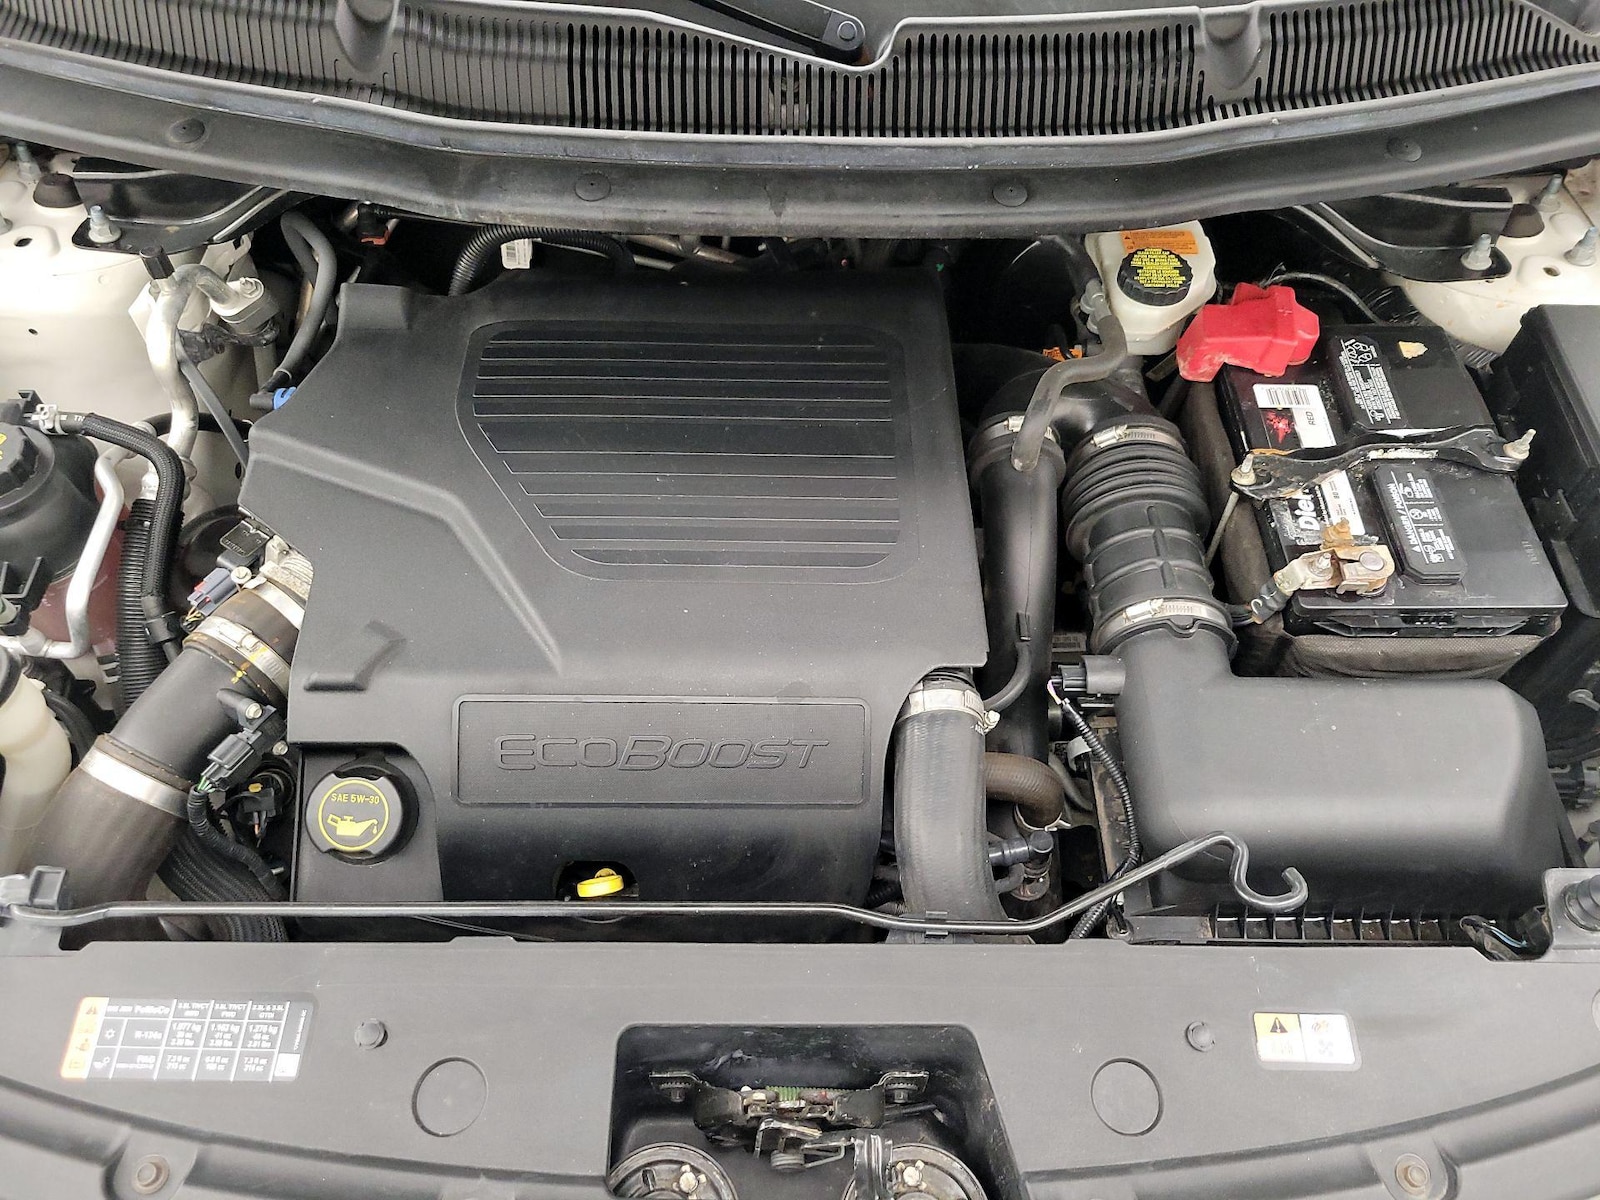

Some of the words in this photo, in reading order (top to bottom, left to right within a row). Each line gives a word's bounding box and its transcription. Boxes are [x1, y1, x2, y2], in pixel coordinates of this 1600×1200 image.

[1307, 411, 1317, 426] RED
[1387, 482, 1404, 509] POISON
[1401, 515, 1418, 545] DANGER
[331, 793, 349, 803] SAE
[350, 794, 380, 805] 5W-30
